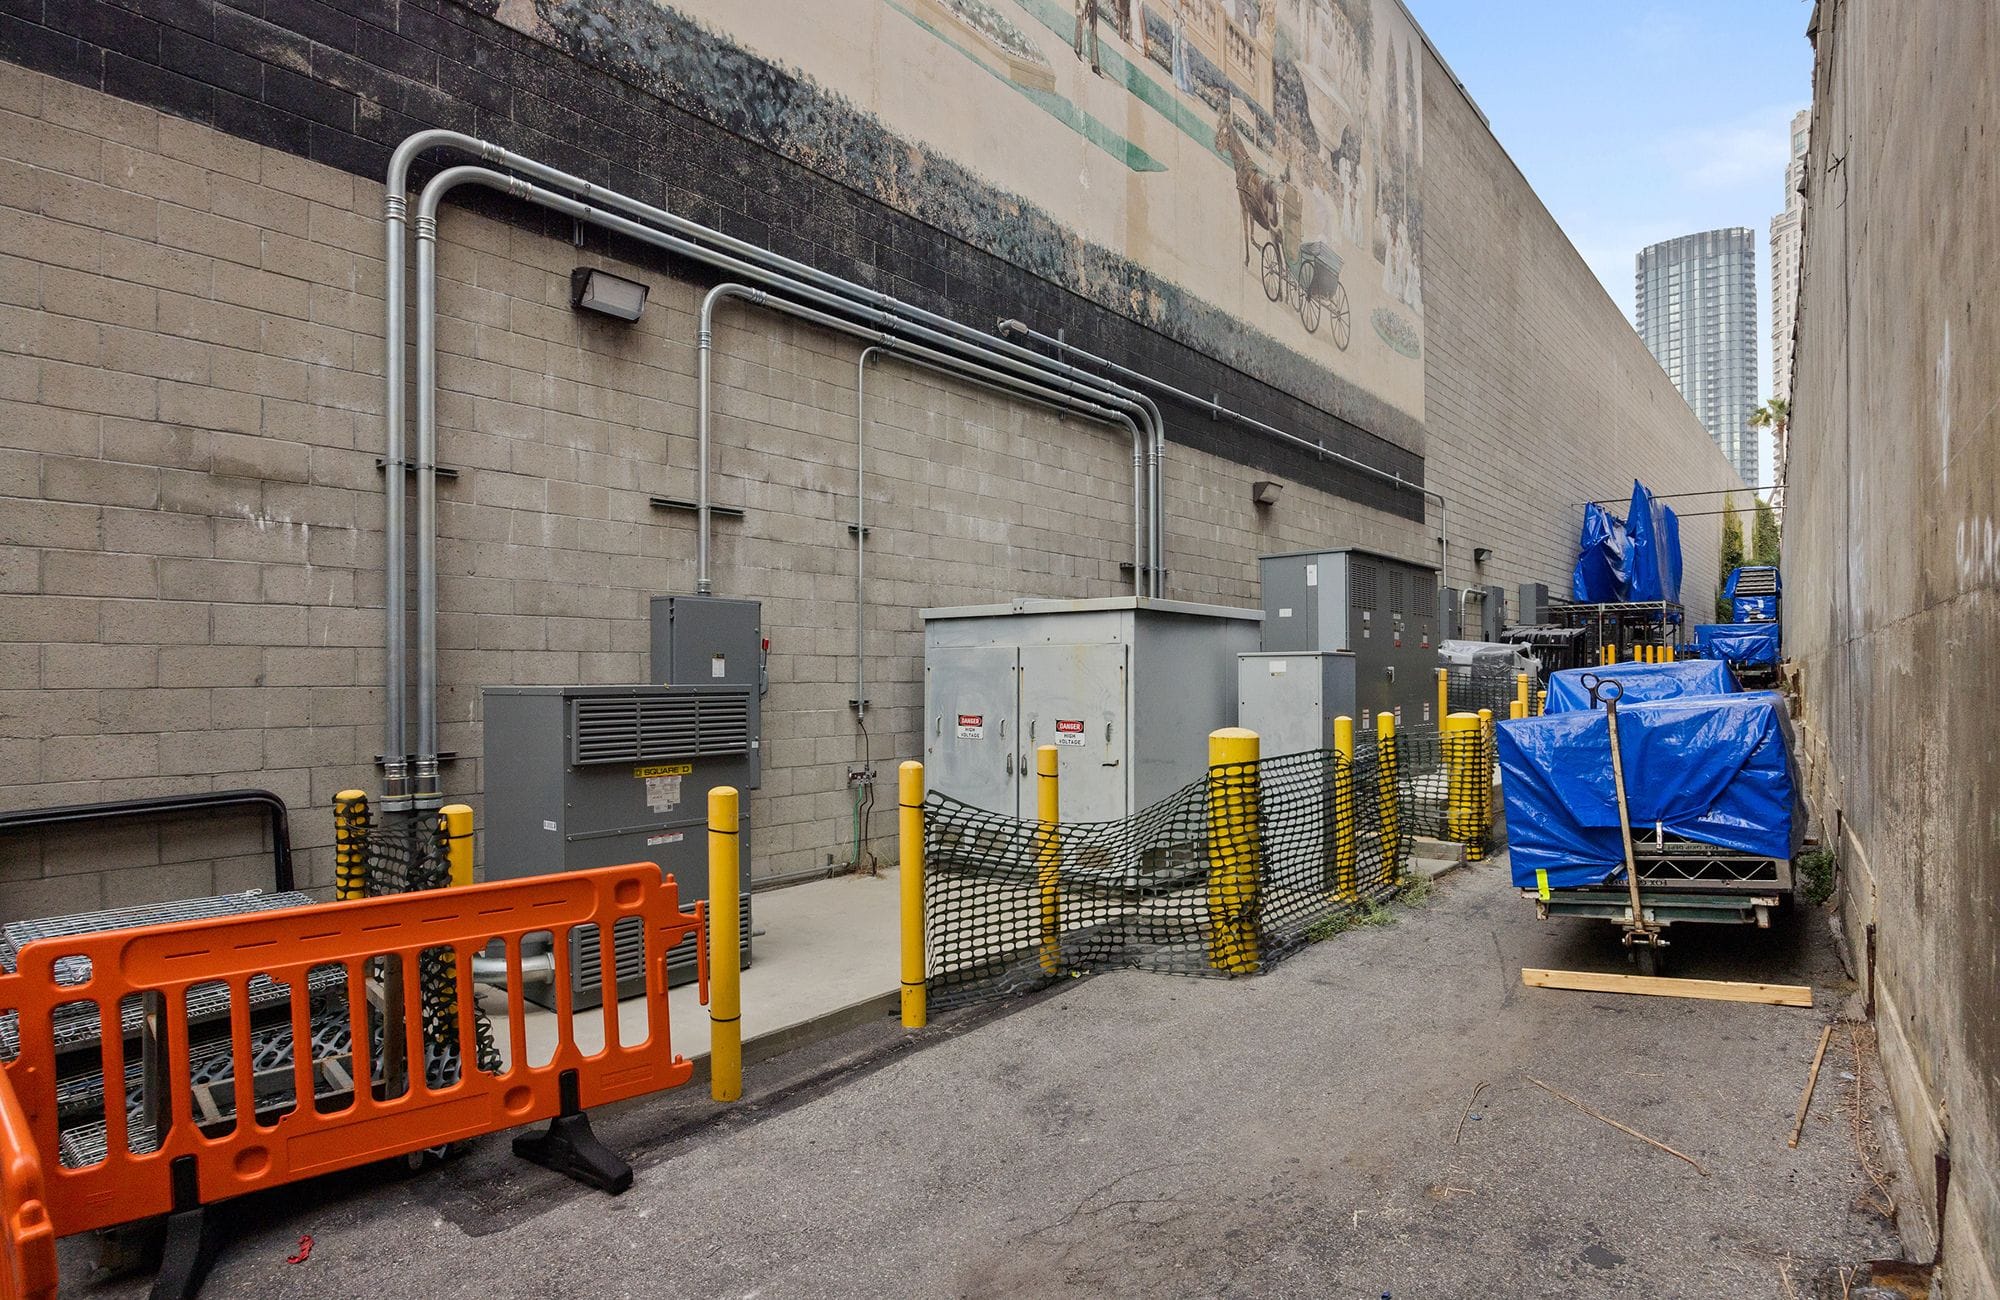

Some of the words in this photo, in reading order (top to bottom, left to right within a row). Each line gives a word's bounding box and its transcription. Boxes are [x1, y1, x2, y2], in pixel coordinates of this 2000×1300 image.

[1059, 722, 1081, 730] DANGER
[644, 766, 679, 776] SQUARE
[682, 765, 689, 773] D
